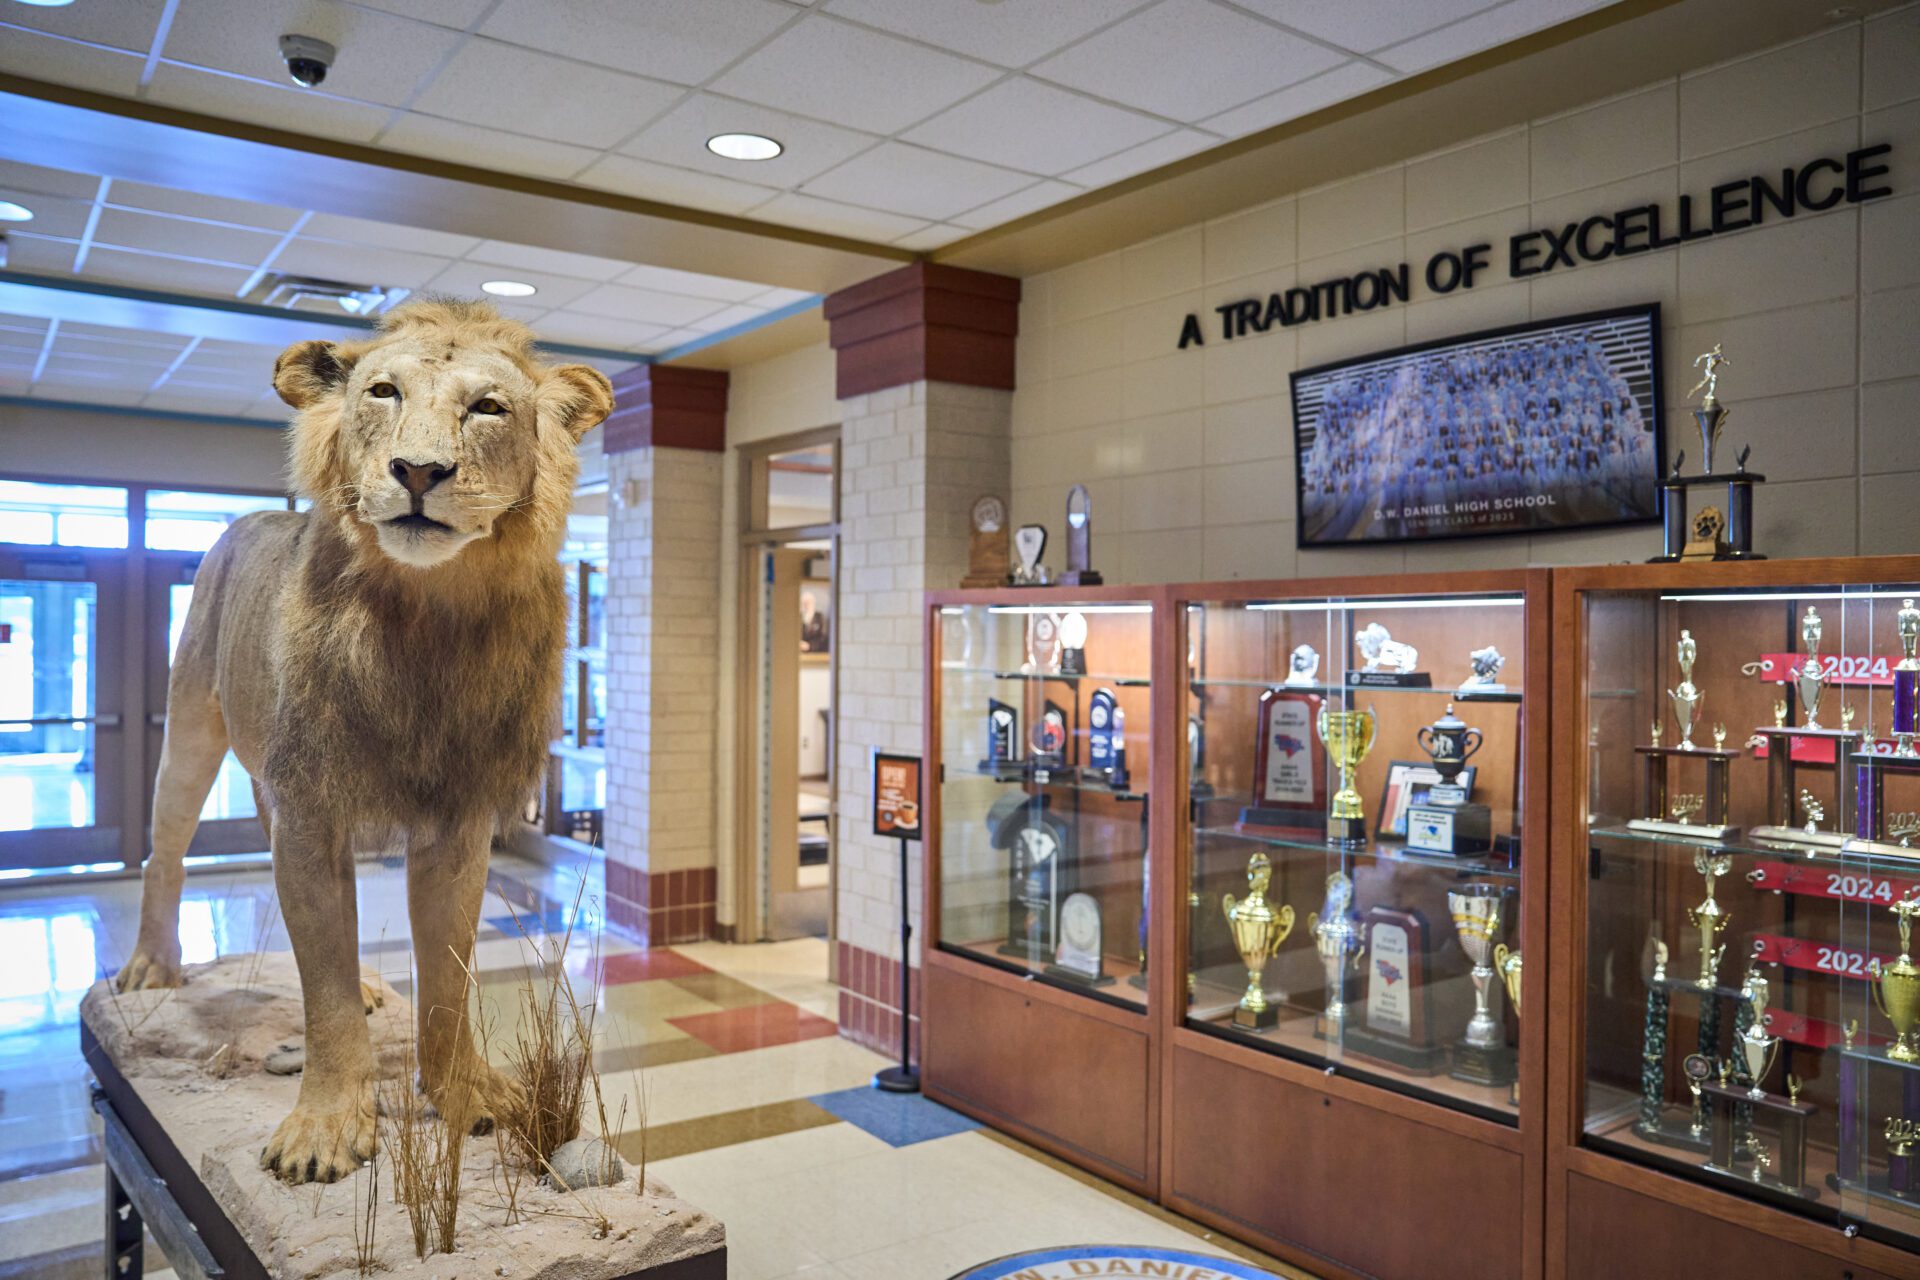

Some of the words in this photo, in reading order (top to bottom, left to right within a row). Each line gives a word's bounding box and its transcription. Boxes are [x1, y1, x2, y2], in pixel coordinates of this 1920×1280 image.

[1177, 313, 1204, 349] A
[1215, 263, 1410, 340] TRADITION
[1425, 243, 1492, 294] OF
[1509, 143, 1893, 278] EXCELLENCE
[1373, 509, 1400, 521] D.W.
[1403, 503, 1450, 518] DANIEL
[1454, 500, 1489, 513] HIGH
[1494, 494, 1557, 510] SCHOOL
[1444, 513, 1475, 526] CLASS
[1823, 655, 1889, 679] 2024
[1826, 873, 1893, 902] 2024
[1816, 947, 1883, 978] 2024
